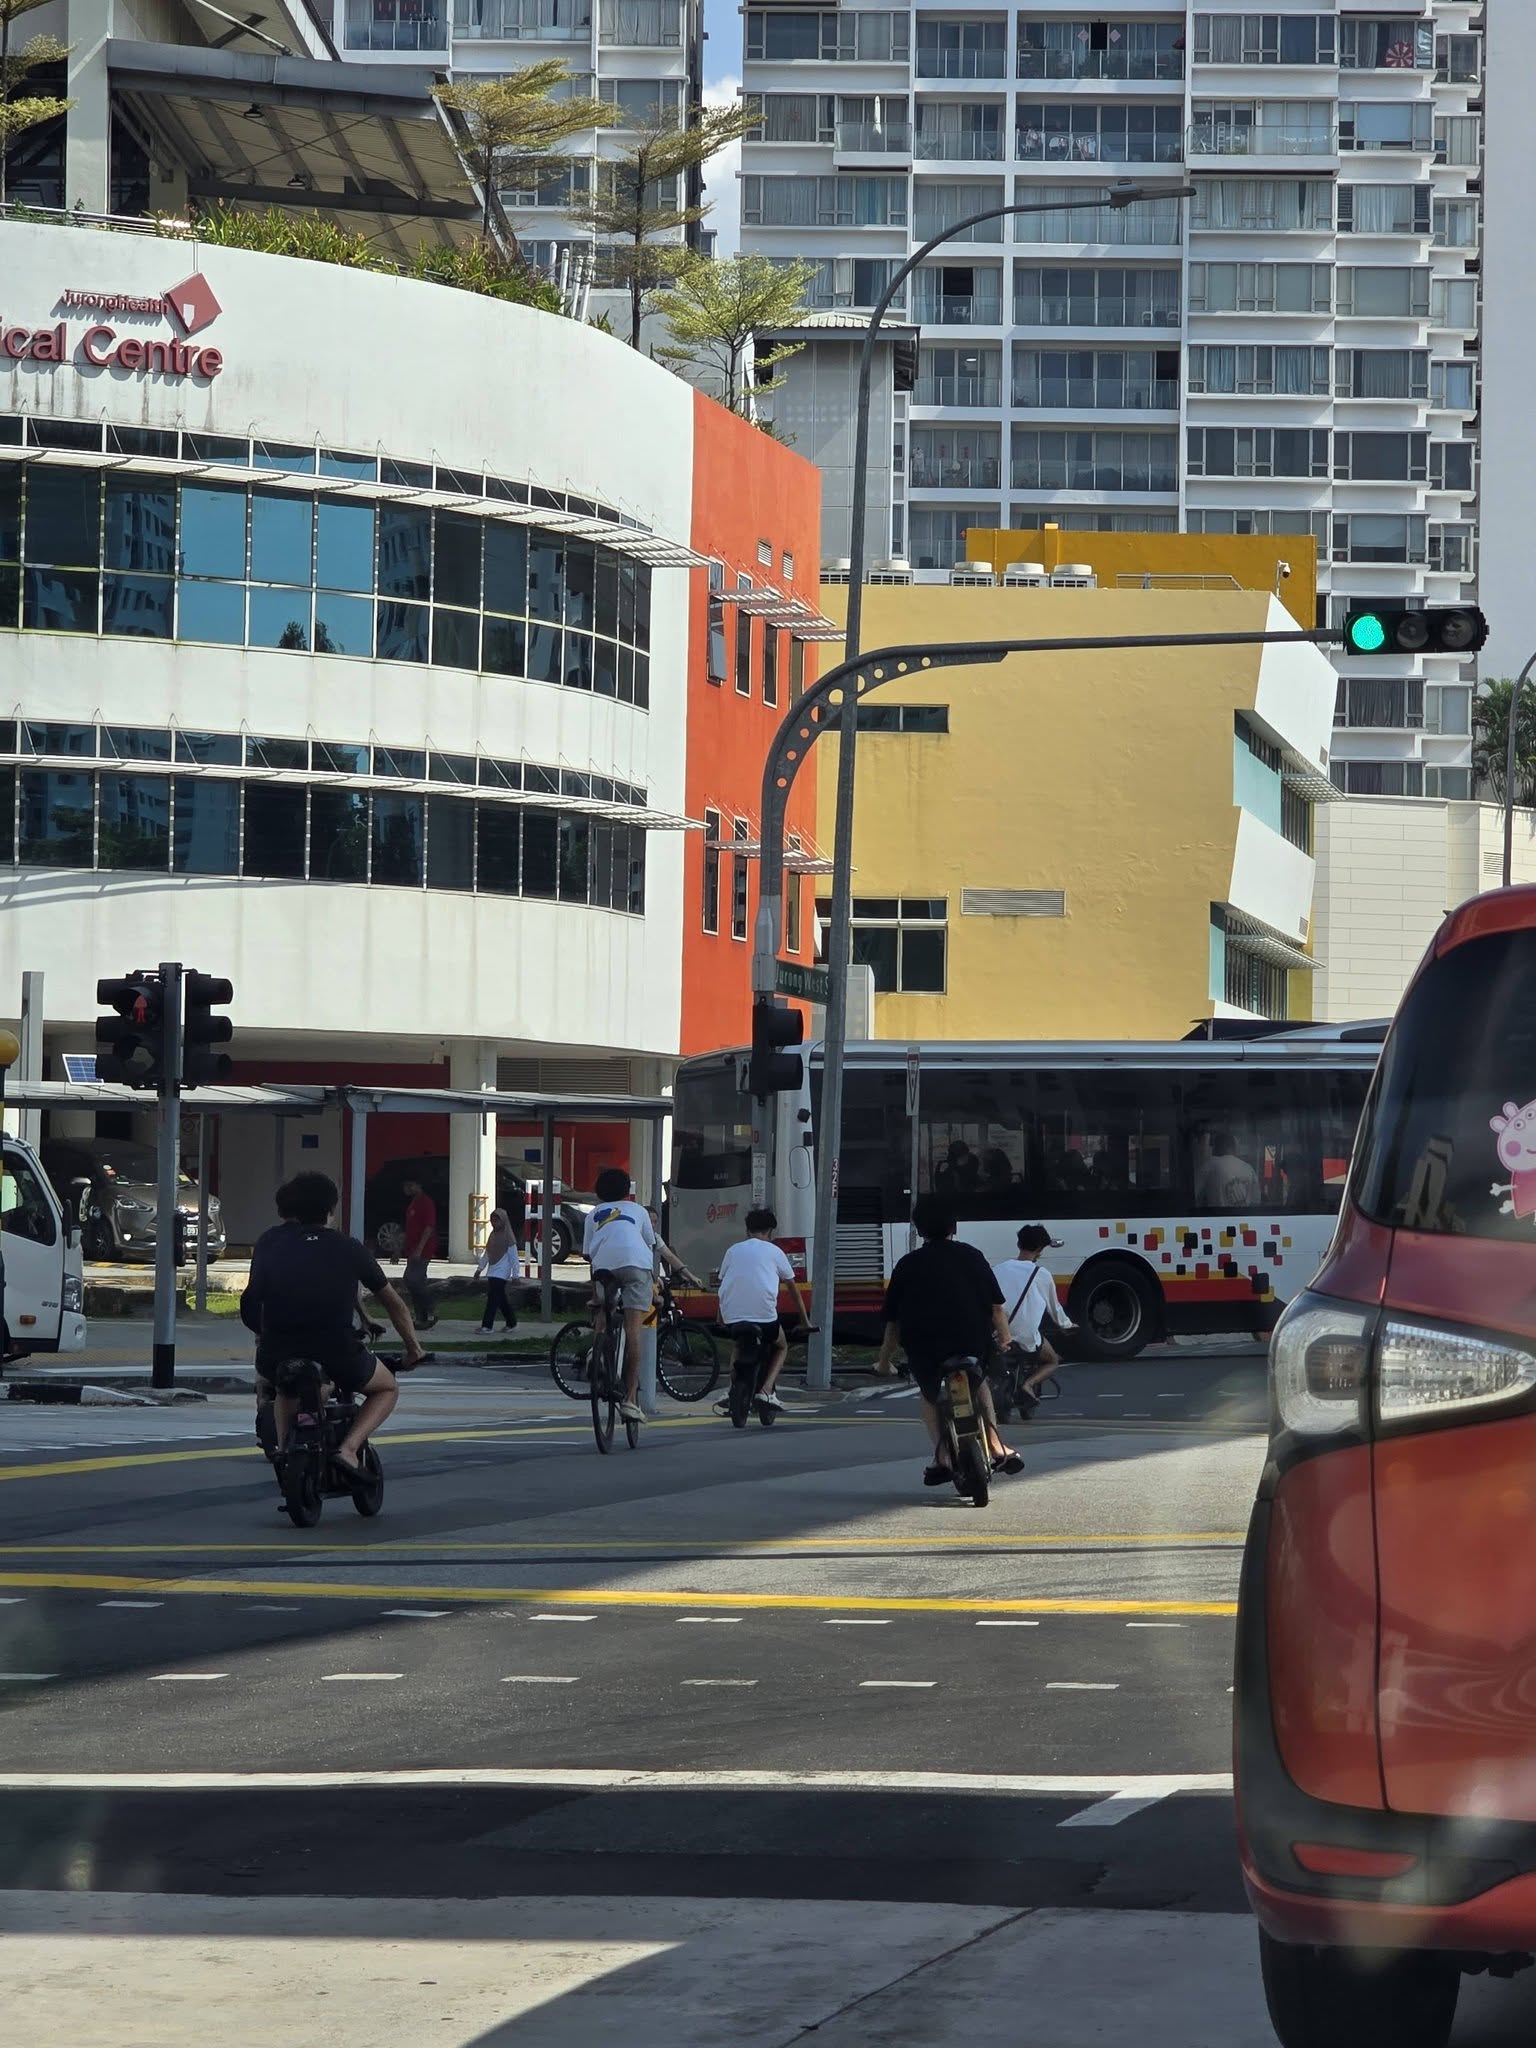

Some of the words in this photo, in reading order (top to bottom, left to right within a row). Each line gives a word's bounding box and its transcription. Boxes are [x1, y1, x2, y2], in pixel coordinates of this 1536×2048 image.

[62, 289, 169, 314] JurongHealth
[83, 325, 223, 378] Centre
[775, 963, 802, 993] Jurong
[804, 969, 823, 994] West
